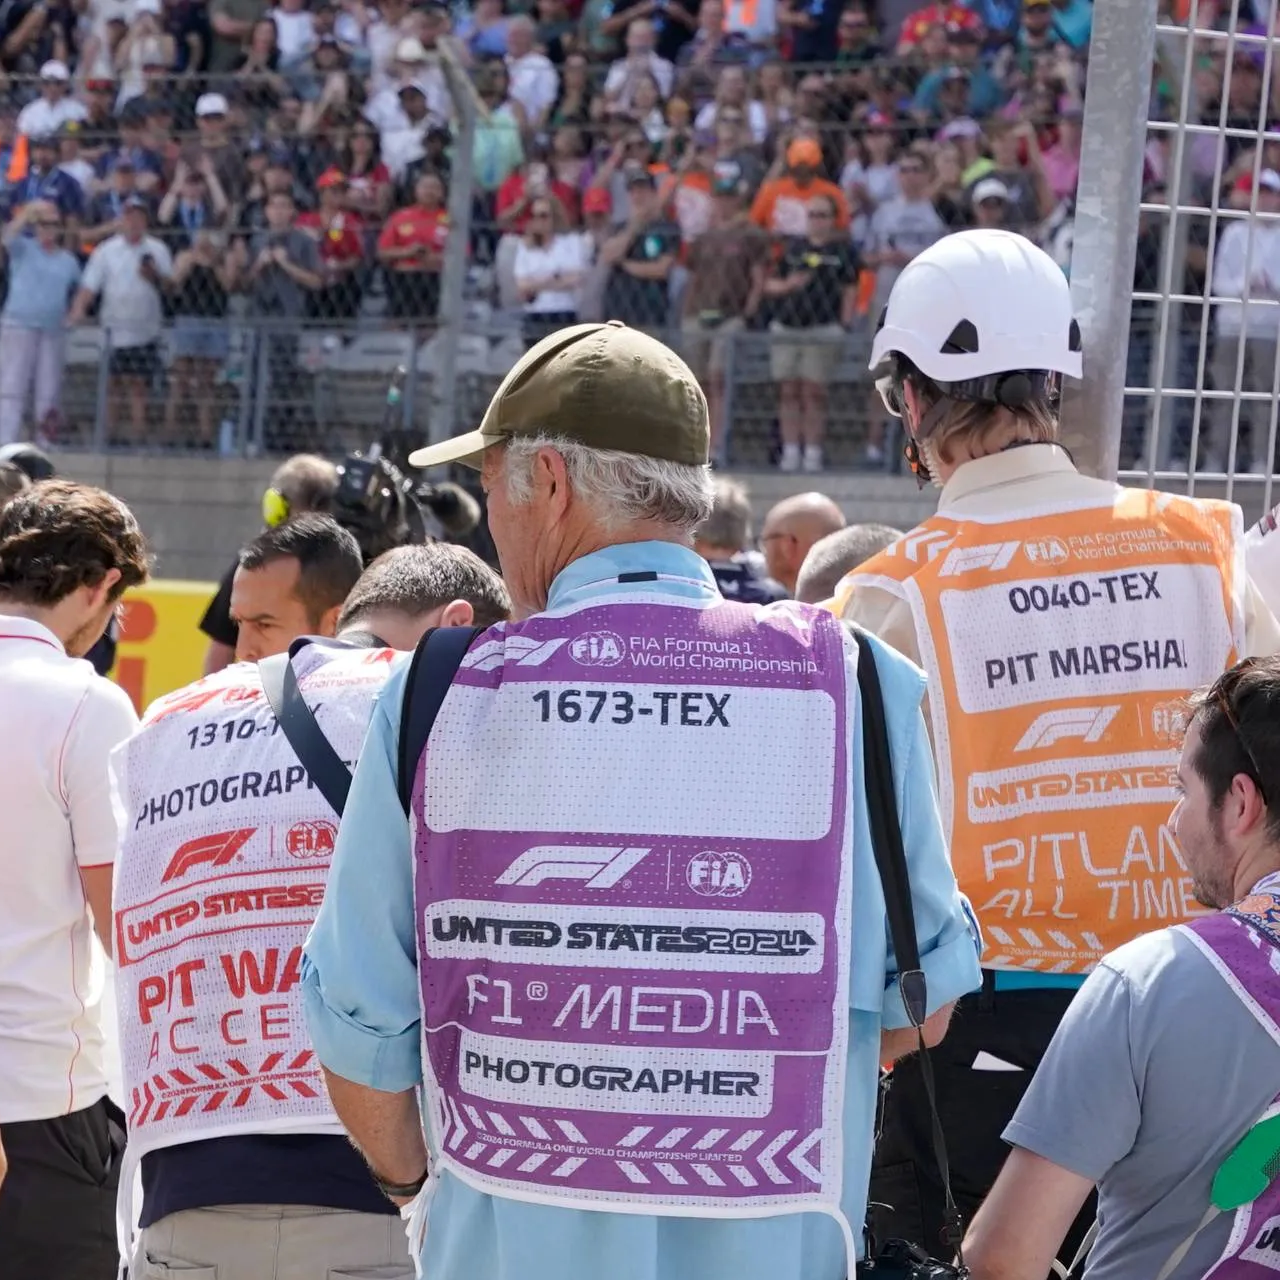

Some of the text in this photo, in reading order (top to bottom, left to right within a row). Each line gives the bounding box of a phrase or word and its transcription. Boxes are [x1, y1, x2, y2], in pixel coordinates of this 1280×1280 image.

[1025, 538, 1066, 563] FIA
[1068, 536, 1094, 547] FIA
[1095, 528, 1150, 544] Formula
[1072, 545, 1117, 560] World
[1008, 571, 1163, 614] 0040-TEX
[570, 634, 623, 663] FIA
[629, 637, 753, 654] FIA Formula 1
[629, 652, 818, 675] World Championship
[984, 654, 1040, 689] PIT
[532, 689, 731, 727] 1673-TEX
[1013, 705, 1122, 752] F1
[135, 762, 330, 831] PHOTOGRAP
[972, 772, 1073, 809] UNITED
[161, 828, 336, 884] F1 FIA
[494, 845, 746, 889] F1 FIA
[982, 824, 1190, 882] PITLAN
[977, 876, 1214, 920] ALL TIME
[138, 946, 303, 1025] PIT WA
[552, 983, 780, 1037] MEDIA
[147, 1003, 290, 1070] ACCE
[464, 1050, 761, 1097] PHOTOGRAPHER
[503, 1137, 552, 1152] FORMULA
[552, 1143, 576, 1155] ONE
[576, 1145, 615, 1157] WORLD
[616, 1149, 698, 1161] CHAMPIONSHIP
[698, 1152, 743, 1163] LIMITED
